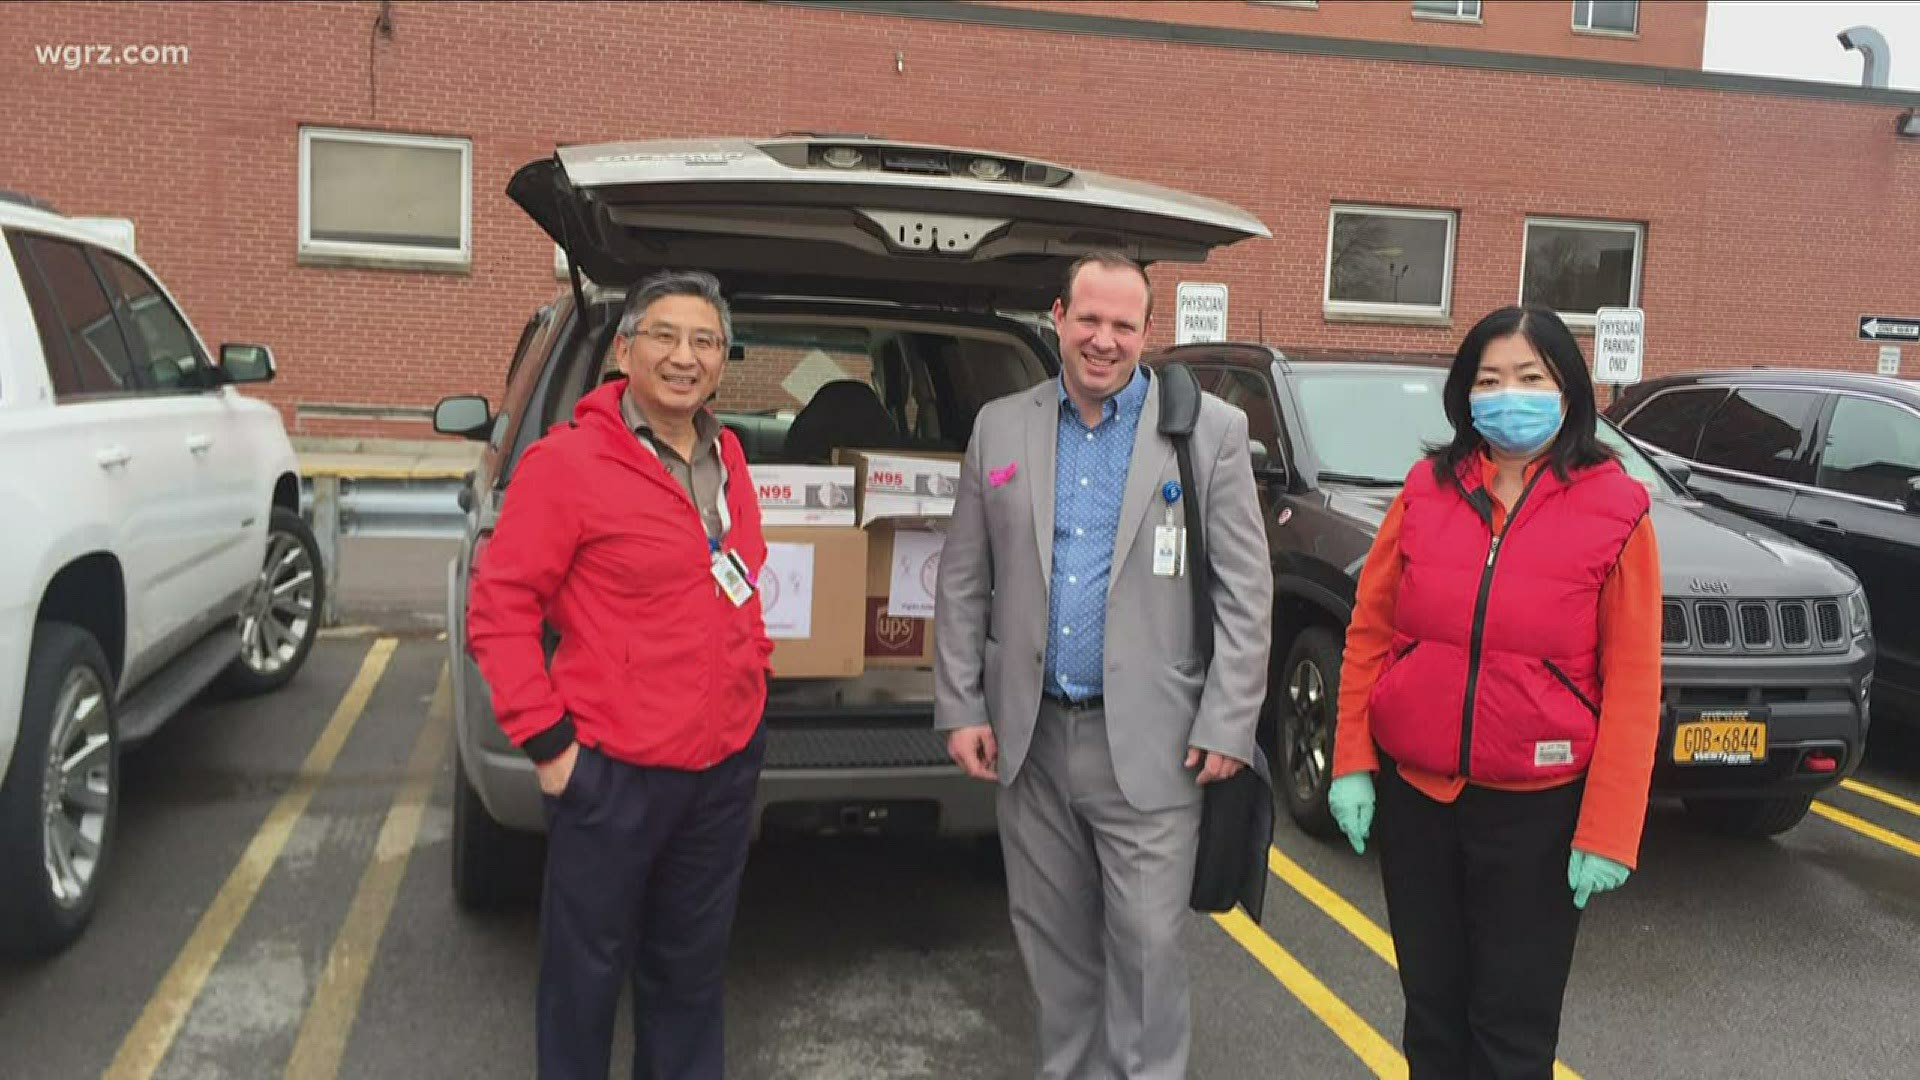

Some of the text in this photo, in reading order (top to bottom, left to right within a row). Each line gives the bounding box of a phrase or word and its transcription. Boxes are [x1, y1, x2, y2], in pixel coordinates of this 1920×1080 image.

[1181, 295, 1223, 312] PHYSICIAN
[1185, 314, 1218, 331] PARKING
[1600, 320, 1641, 336] PHYSICIAN
[1877, 324, 1916, 336] ONE WAY
[1603, 338, 1635, 354] PARKING
[1609, 356, 1628, 372] ONLY
[874, 471, 903, 486] N95
[759, 485, 792, 499] N95
[1689, 577, 1729, 595] Jeep
[880, 618, 910, 641] ups
